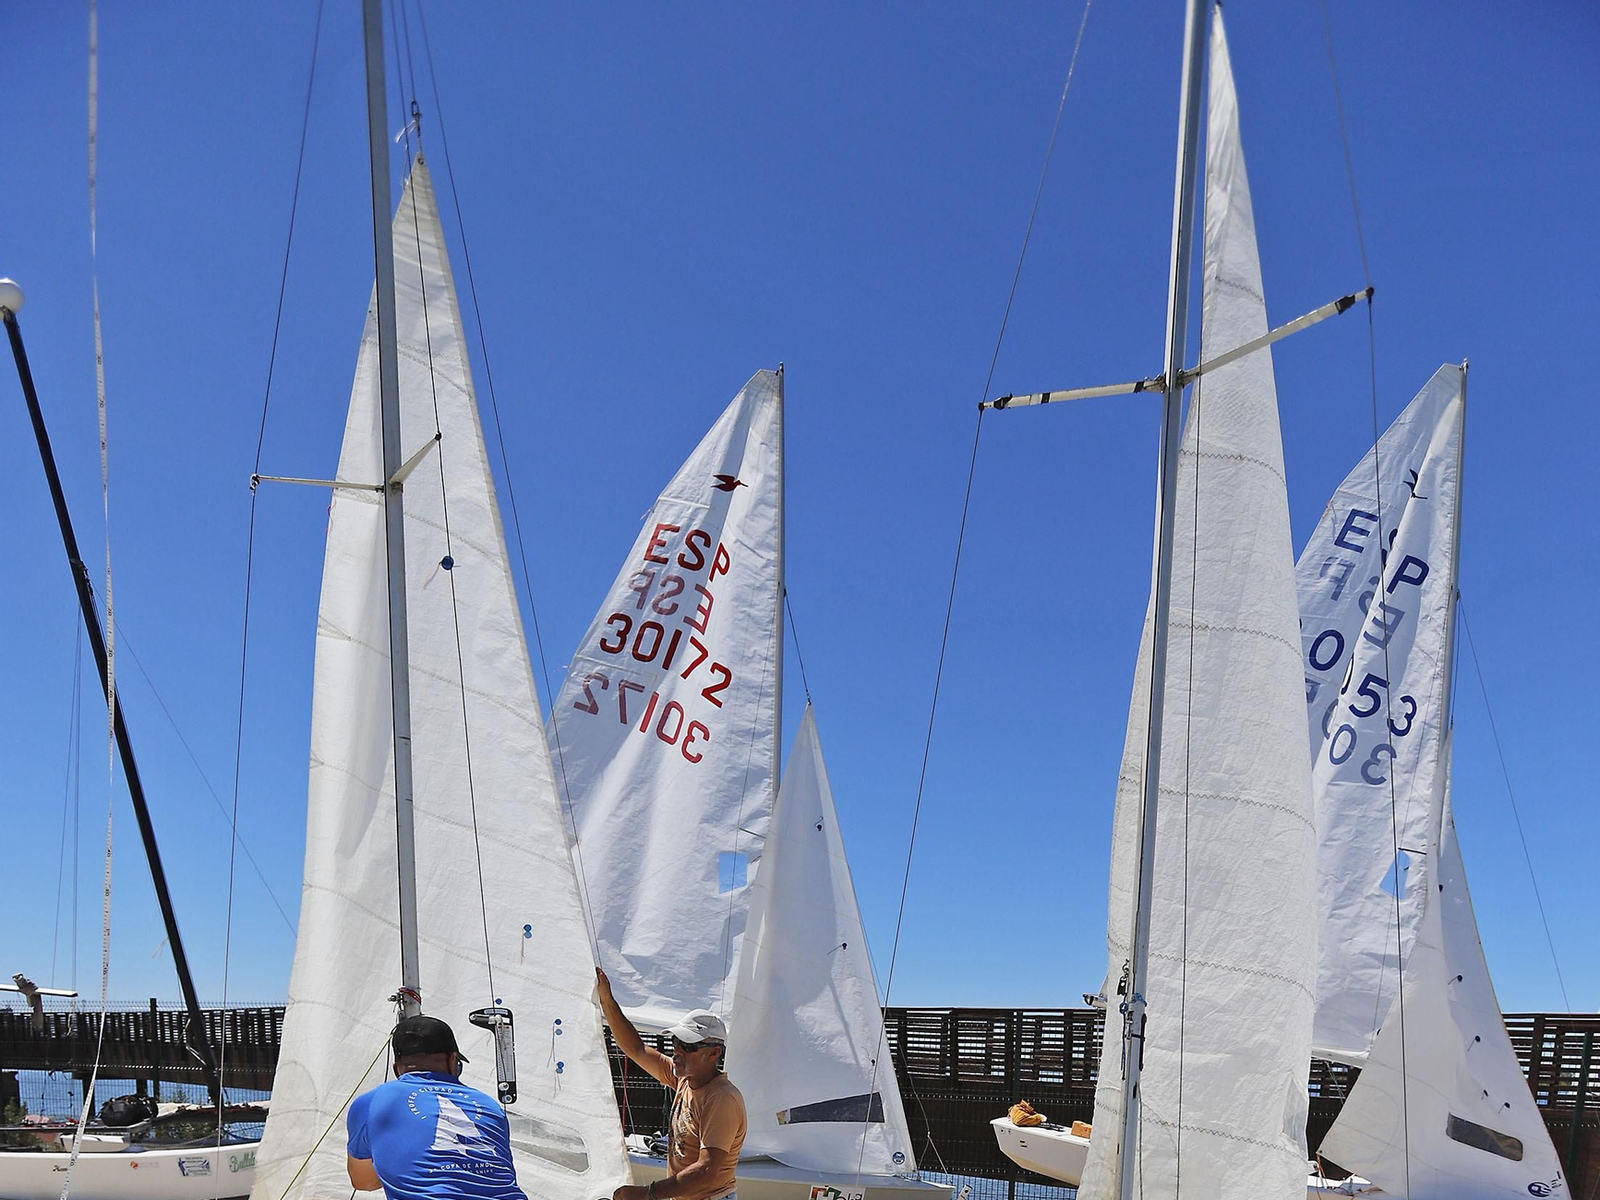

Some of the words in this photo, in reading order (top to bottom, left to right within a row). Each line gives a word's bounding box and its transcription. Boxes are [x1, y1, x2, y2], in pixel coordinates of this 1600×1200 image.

[643, 523, 730, 582] ESP
[600, 612, 733, 708] 30172
[407, 1092, 420, 1115] TROFEO
[441, 1163, 460, 1171] COPA
